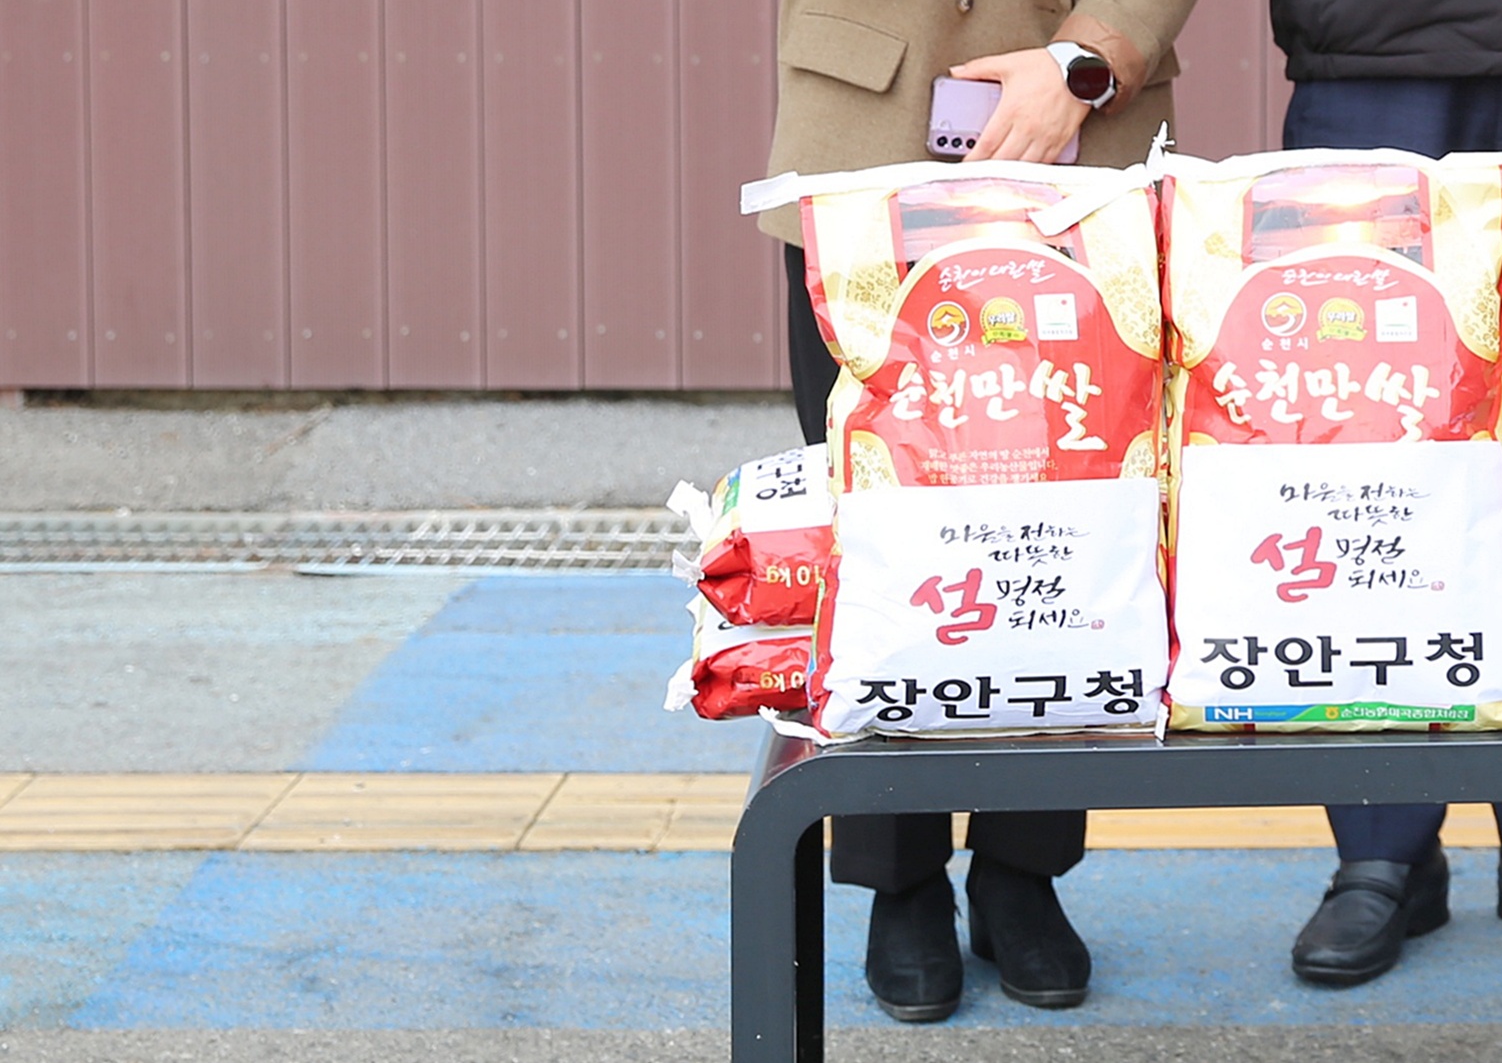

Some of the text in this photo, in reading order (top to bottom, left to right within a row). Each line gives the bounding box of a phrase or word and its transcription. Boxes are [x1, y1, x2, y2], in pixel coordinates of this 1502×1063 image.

[889, 359, 1107, 451] 순천만쌀
[1213, 358, 1440, 441] 순천만쌀
[1359, 482, 1433, 502] 전하는
[1327, 505, 1414, 527] 따뜻한
[1020, 522, 1090, 541] 전하는
[988, 545, 1074, 567] 따뜻한
[1250, 526, 1406, 603] 설 명절
[1348, 569, 1429, 589] 되세요
[910, 567, 1066, 646] 설 명절
[1009, 608, 1089, 630] 되세요
[1200, 632, 1484, 690] 장안구청
[856, 670, 1143, 722] 장안구청
[1214, 707, 1252, 720] NH
